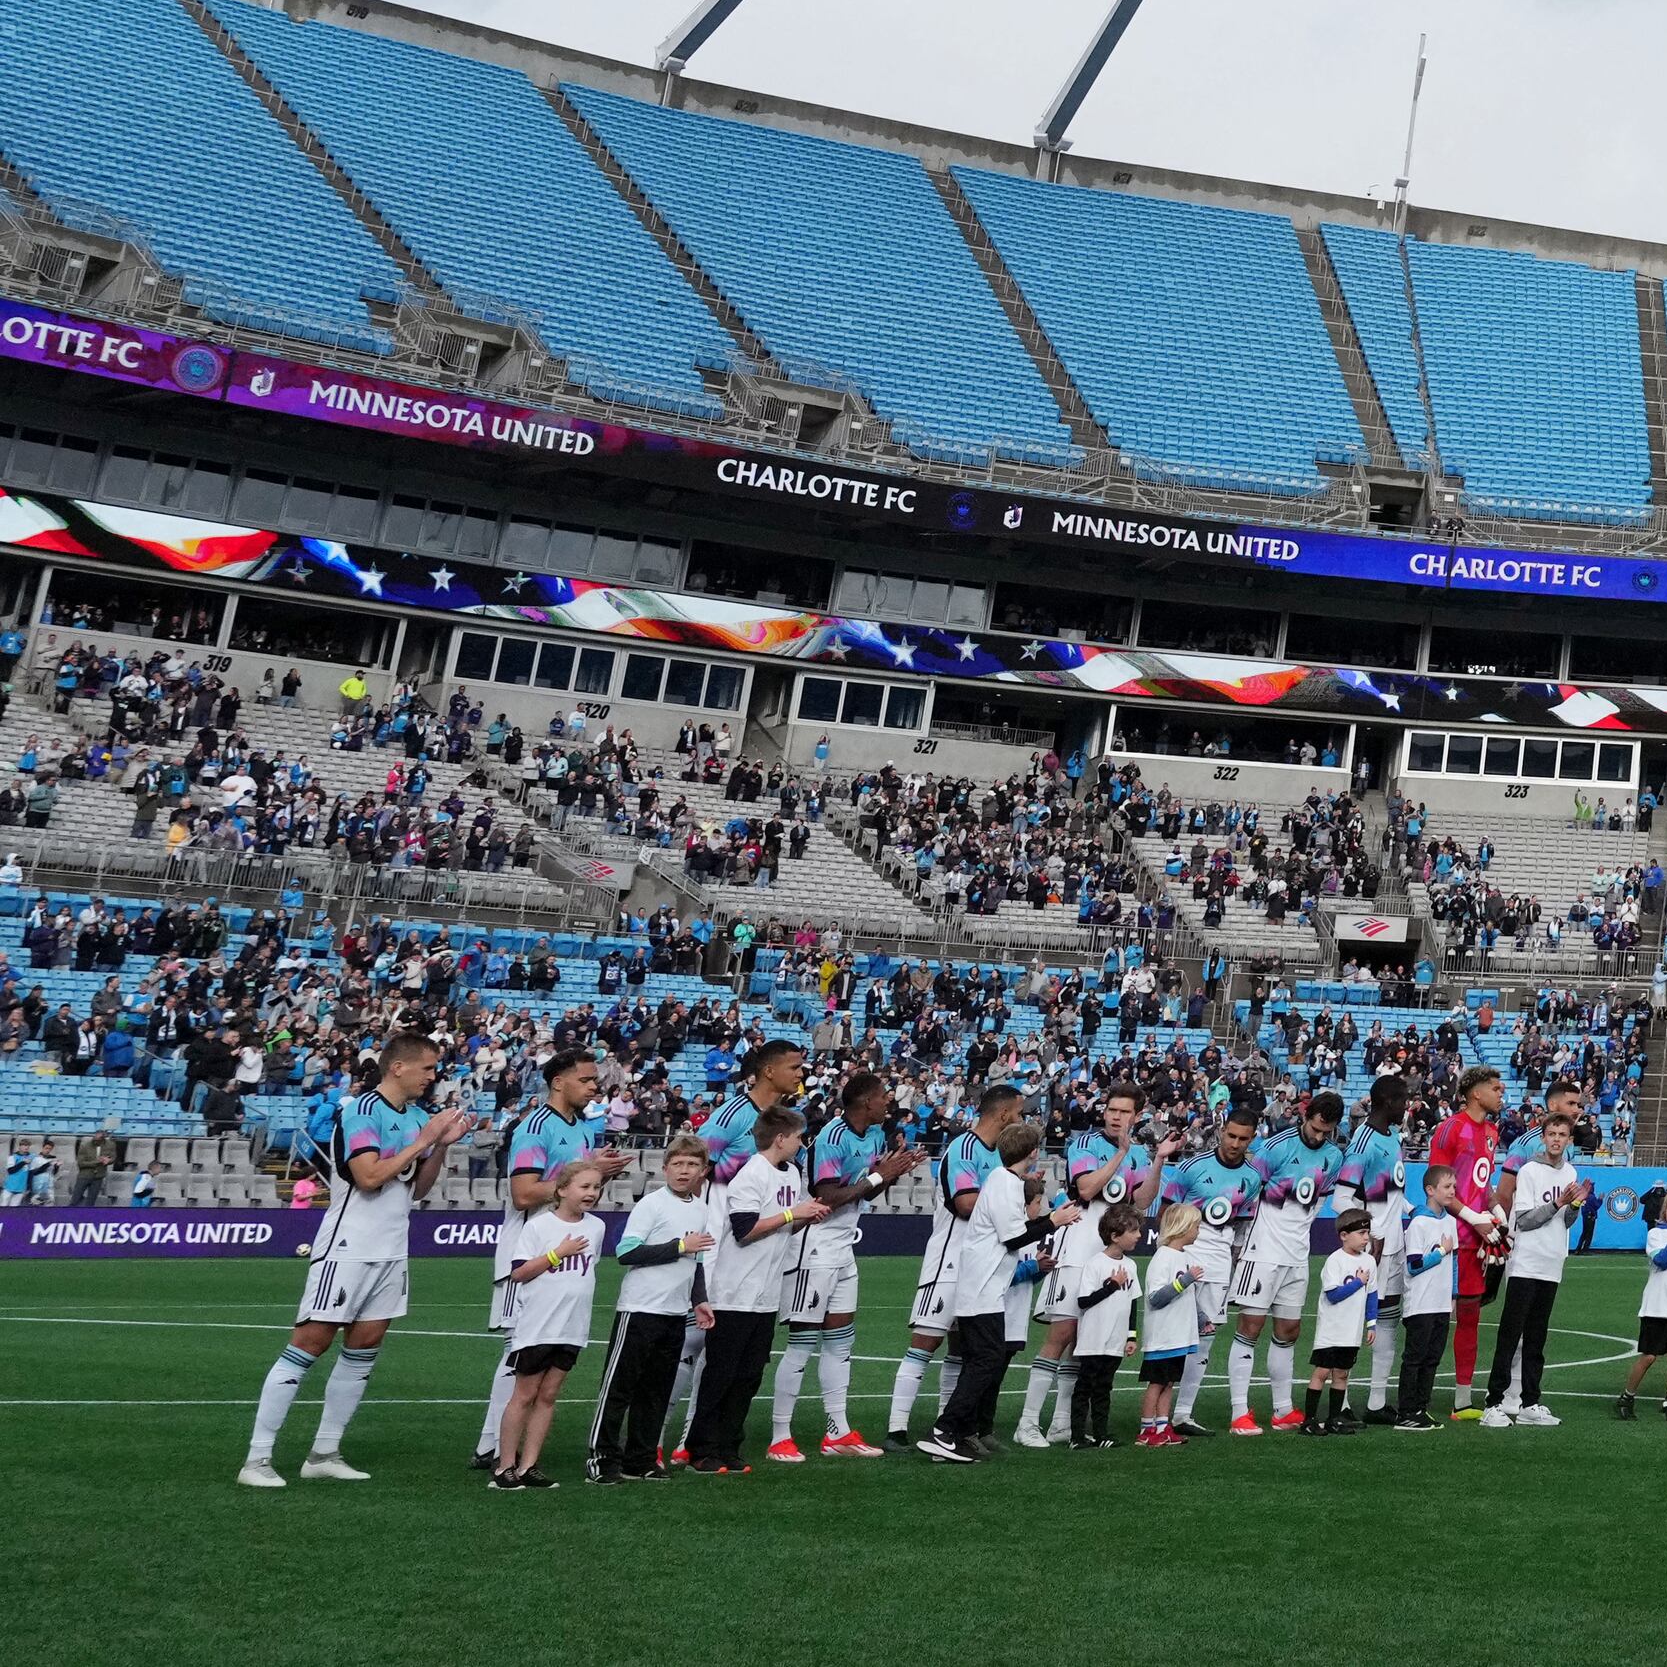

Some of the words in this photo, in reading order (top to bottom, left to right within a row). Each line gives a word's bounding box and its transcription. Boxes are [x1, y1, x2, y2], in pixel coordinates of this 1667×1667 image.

[0, 316, 96, 358] OTTE
[99, 338, 144, 369] FC
[310, 379, 485, 437] MINNESOTA
[492, 415, 595, 456] UNITED
[716, 458, 880, 507] CHARLOTTE
[884, 487, 918, 513] FC
[1052, 511, 1201, 552] MINNESOTA
[1206, 533, 1300, 561] UNITED
[1409, 552, 1566, 585] CHARLOTTE
[1570, 564, 1602, 587] FC
[203, 654, 233, 673] 319
[584, 702, 611, 720] 320
[913, 739, 938, 755] 321
[1213, 765, 1240, 781] 322
[1504, 784, 1530, 799] 323
[1543, 1186, 1562, 1203] all
[30, 1221, 180, 1244] MINNESOTA
[184, 1222, 274, 1244] UNITED
